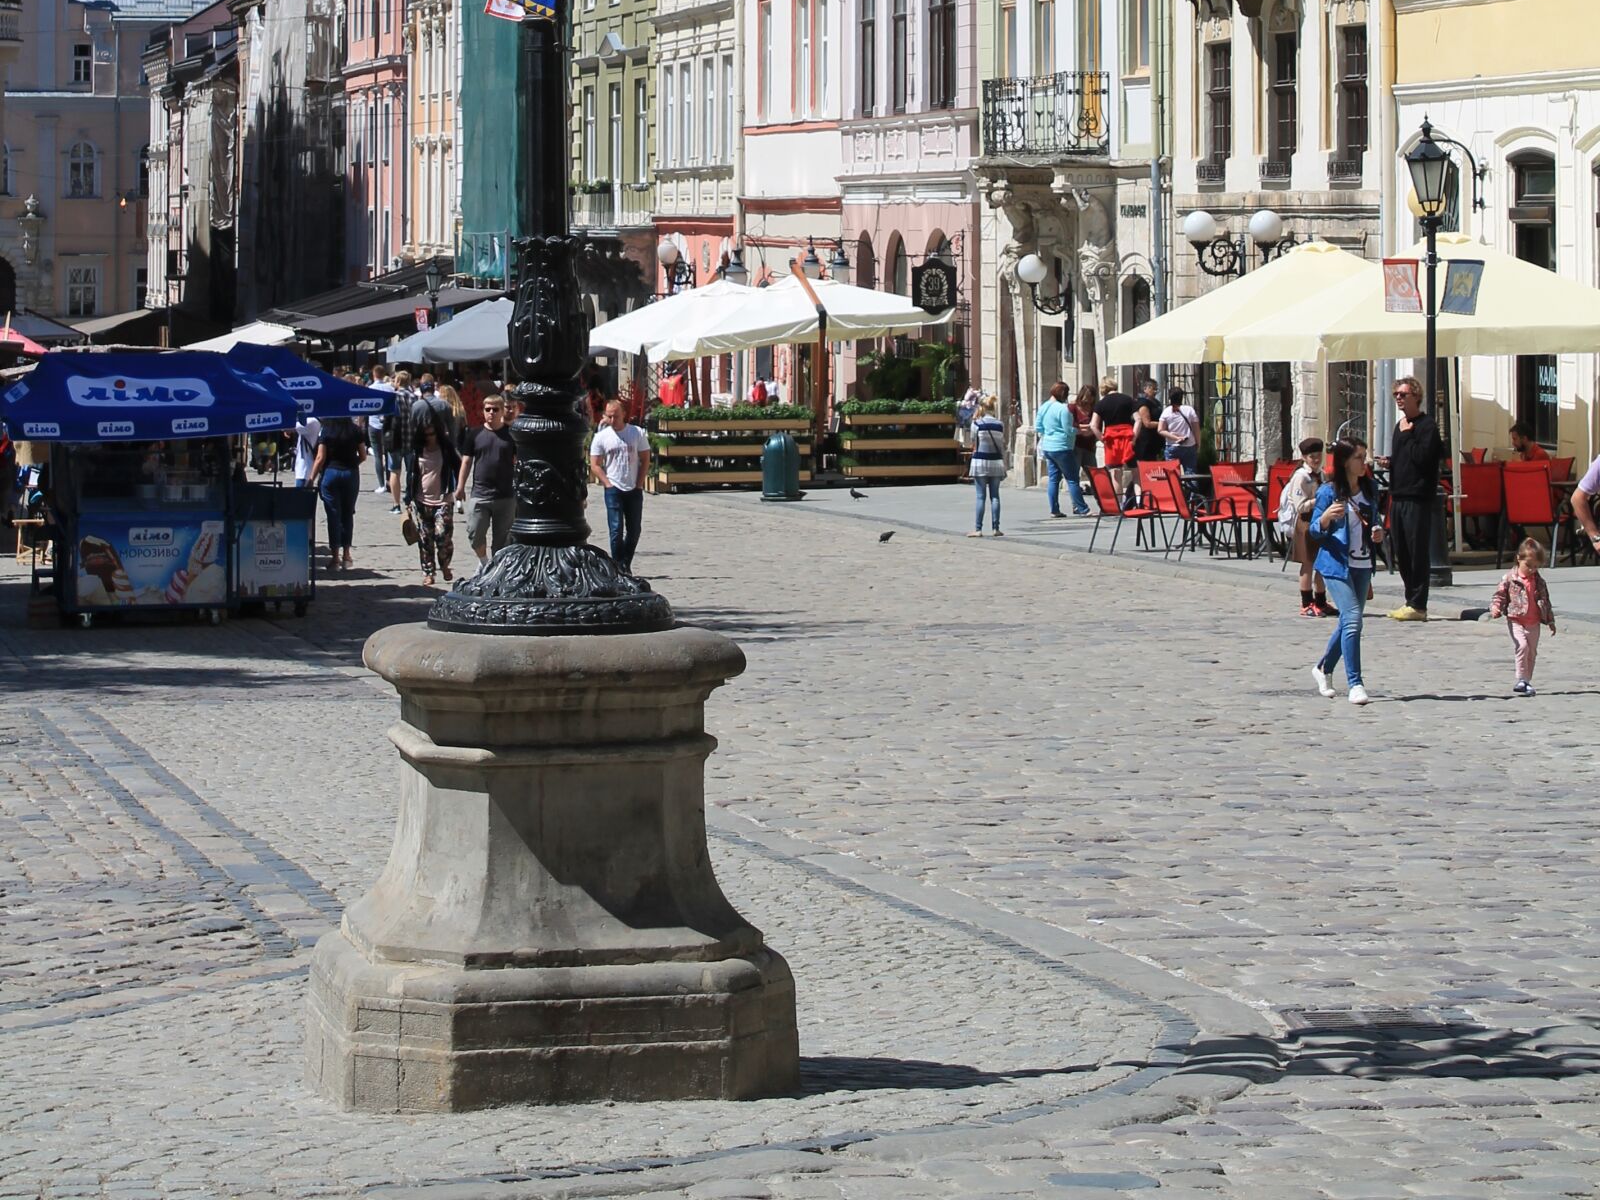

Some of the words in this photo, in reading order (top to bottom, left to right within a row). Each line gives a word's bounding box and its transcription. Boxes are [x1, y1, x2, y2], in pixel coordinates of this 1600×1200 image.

[928, 277, 940, 291] 39
[282, 379, 317, 388] імо
[81, 379, 201, 402] лімо
[351, 399, 381, 409] лімо
[248, 414, 280, 425] лімо
[26, 424, 58, 434] лімо
[100, 423, 132, 434] лімо
[174, 420, 206, 431] лімо
[132, 528, 170, 541] лімо
[119, 547, 180, 559] МОРОЗИВО
